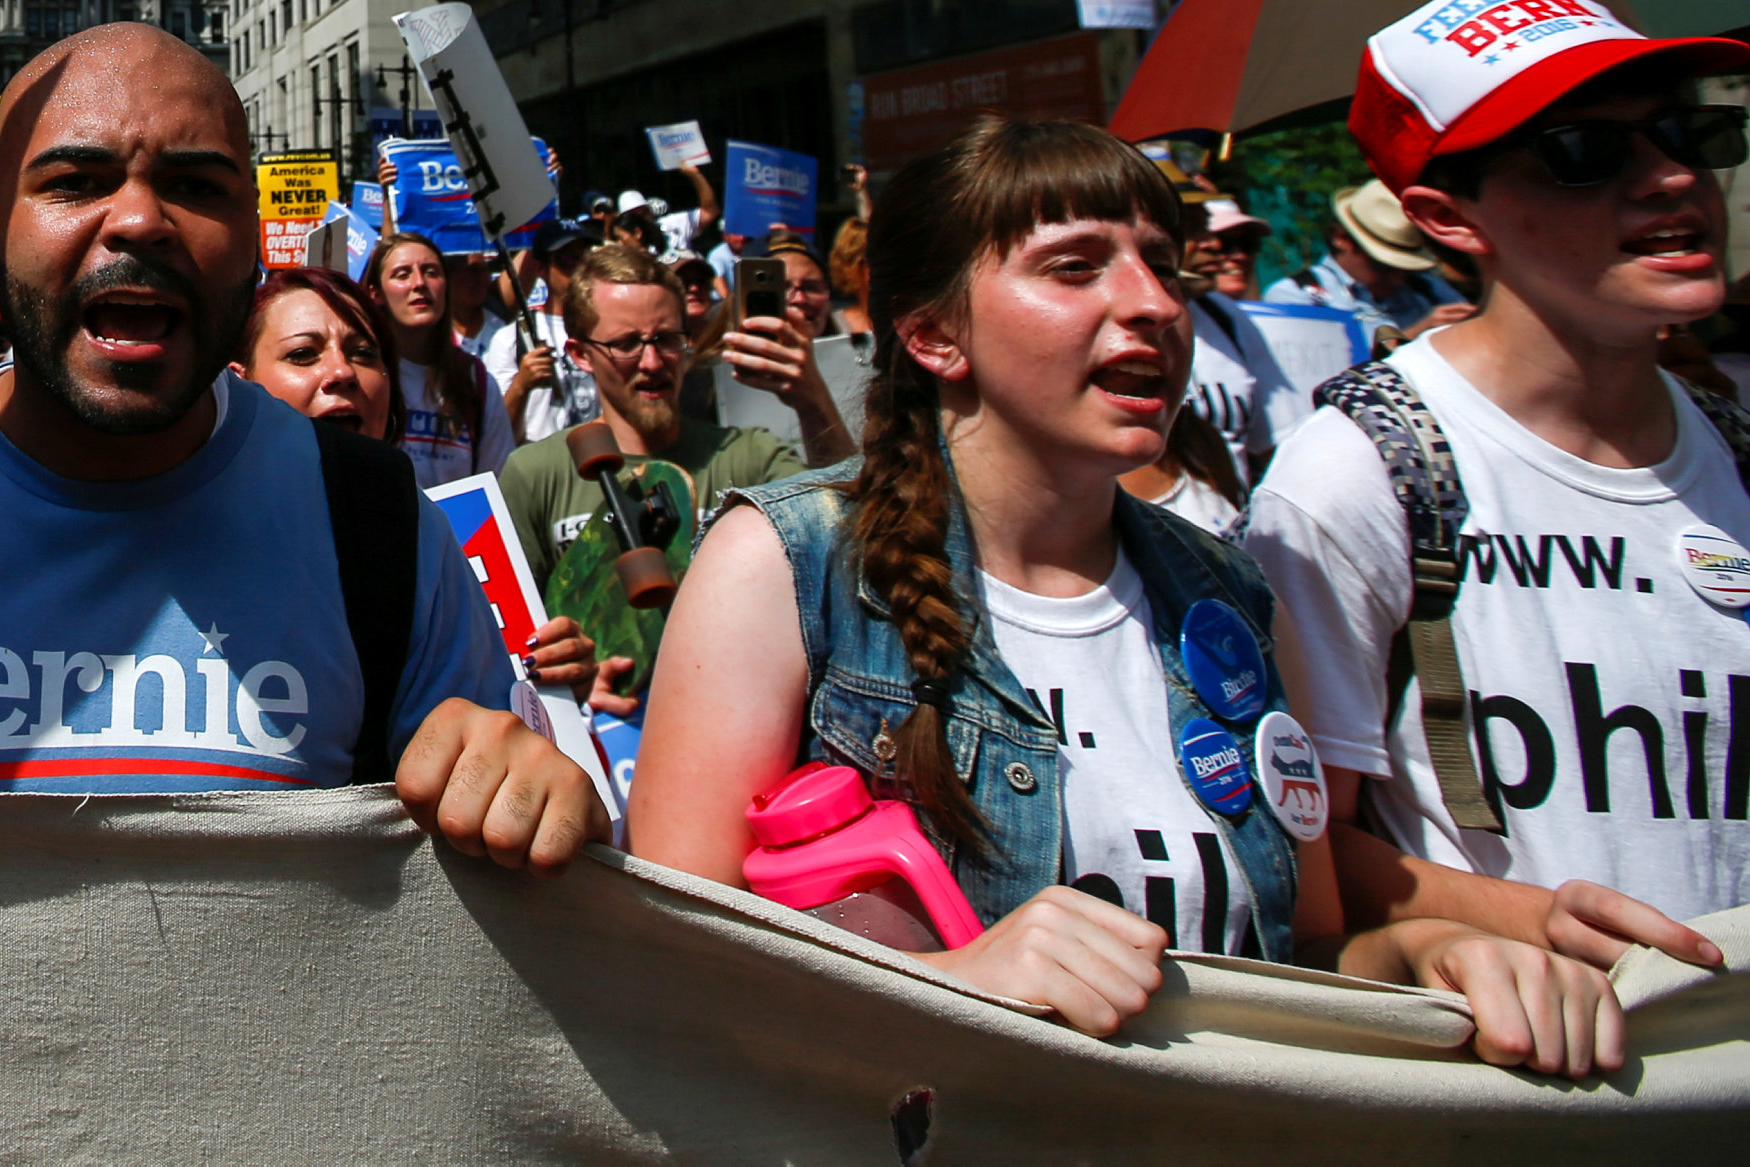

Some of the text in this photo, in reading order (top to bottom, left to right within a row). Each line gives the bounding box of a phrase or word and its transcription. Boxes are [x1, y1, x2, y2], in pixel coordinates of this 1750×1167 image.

[270, 165, 326, 176] America
[744, 158, 811, 195] Bernie
[284, 177, 312, 188] Was
[270, 189, 327, 205] NEVER
[278, 204, 321, 217] Great!
[265, 221, 284, 236] We
[268, 250, 292, 264] This
[1190, 745, 1241, 776] Bernie
